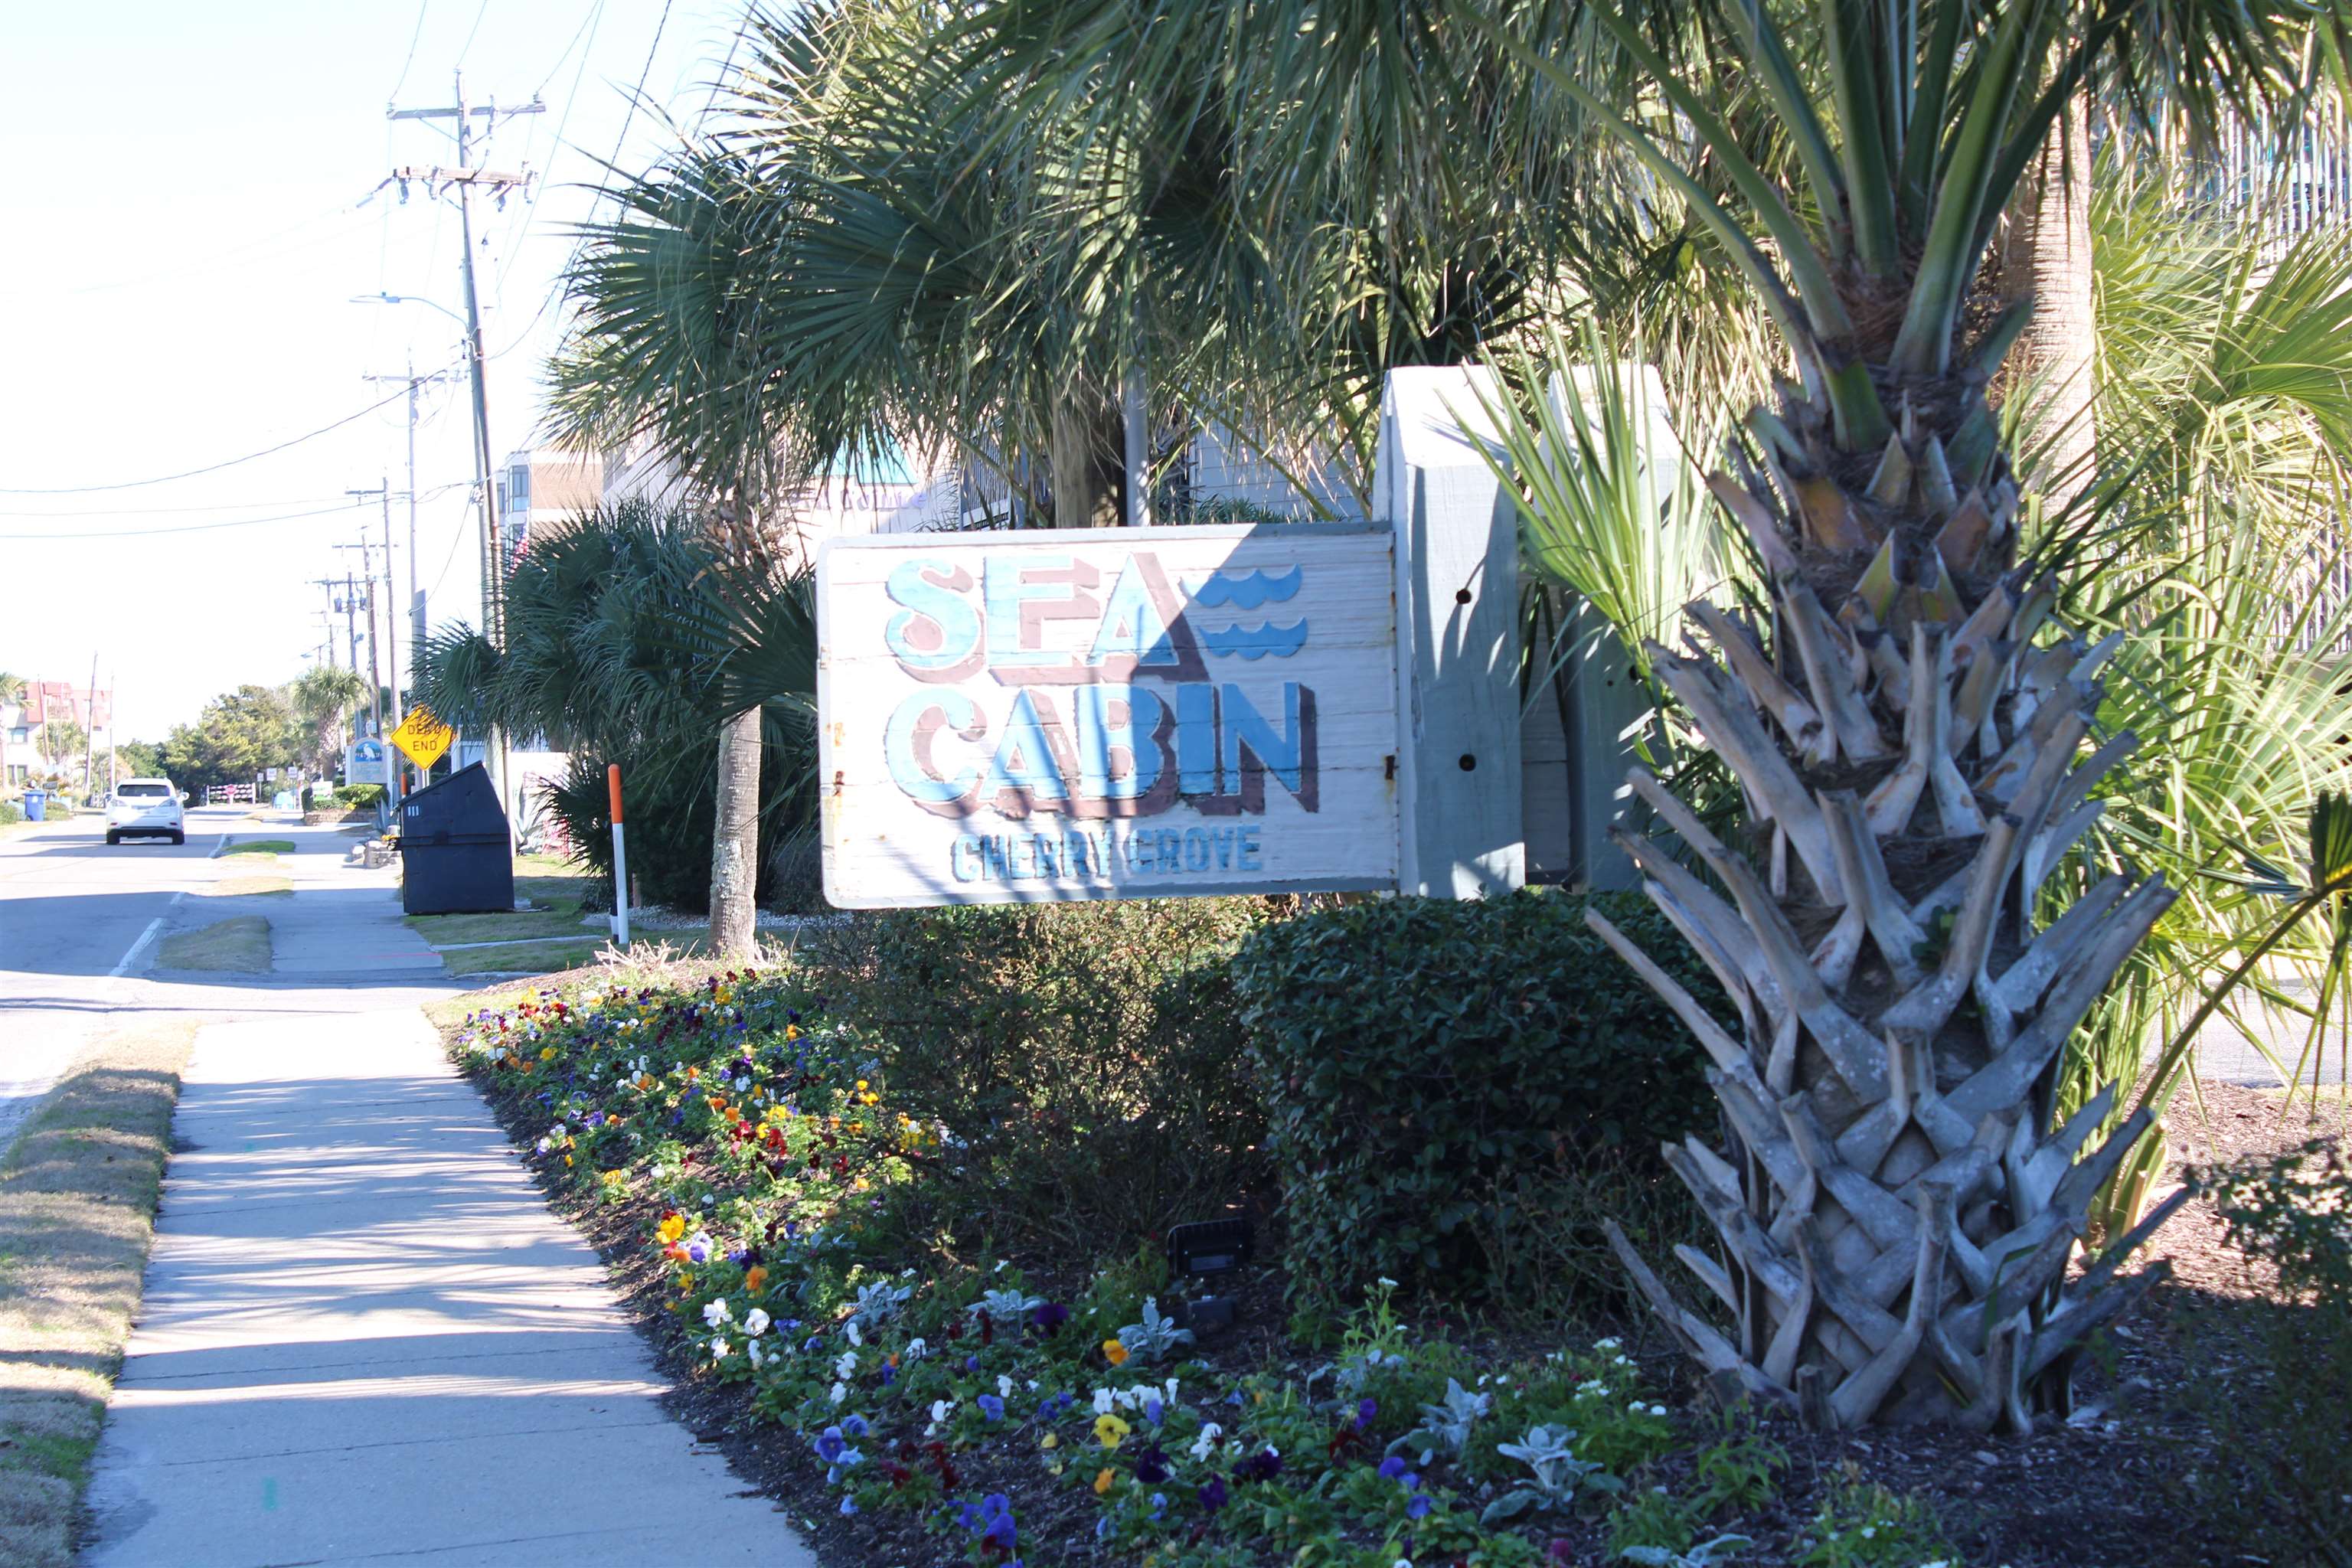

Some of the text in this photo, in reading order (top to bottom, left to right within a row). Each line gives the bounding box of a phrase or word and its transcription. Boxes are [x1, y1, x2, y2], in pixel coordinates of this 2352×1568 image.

[886, 552, 1211, 686] SEA
[413, 740, 437, 751] END
[884, 681, 1318, 819] CABIN
[951, 825, 1262, 883] CHERRY GROVE
